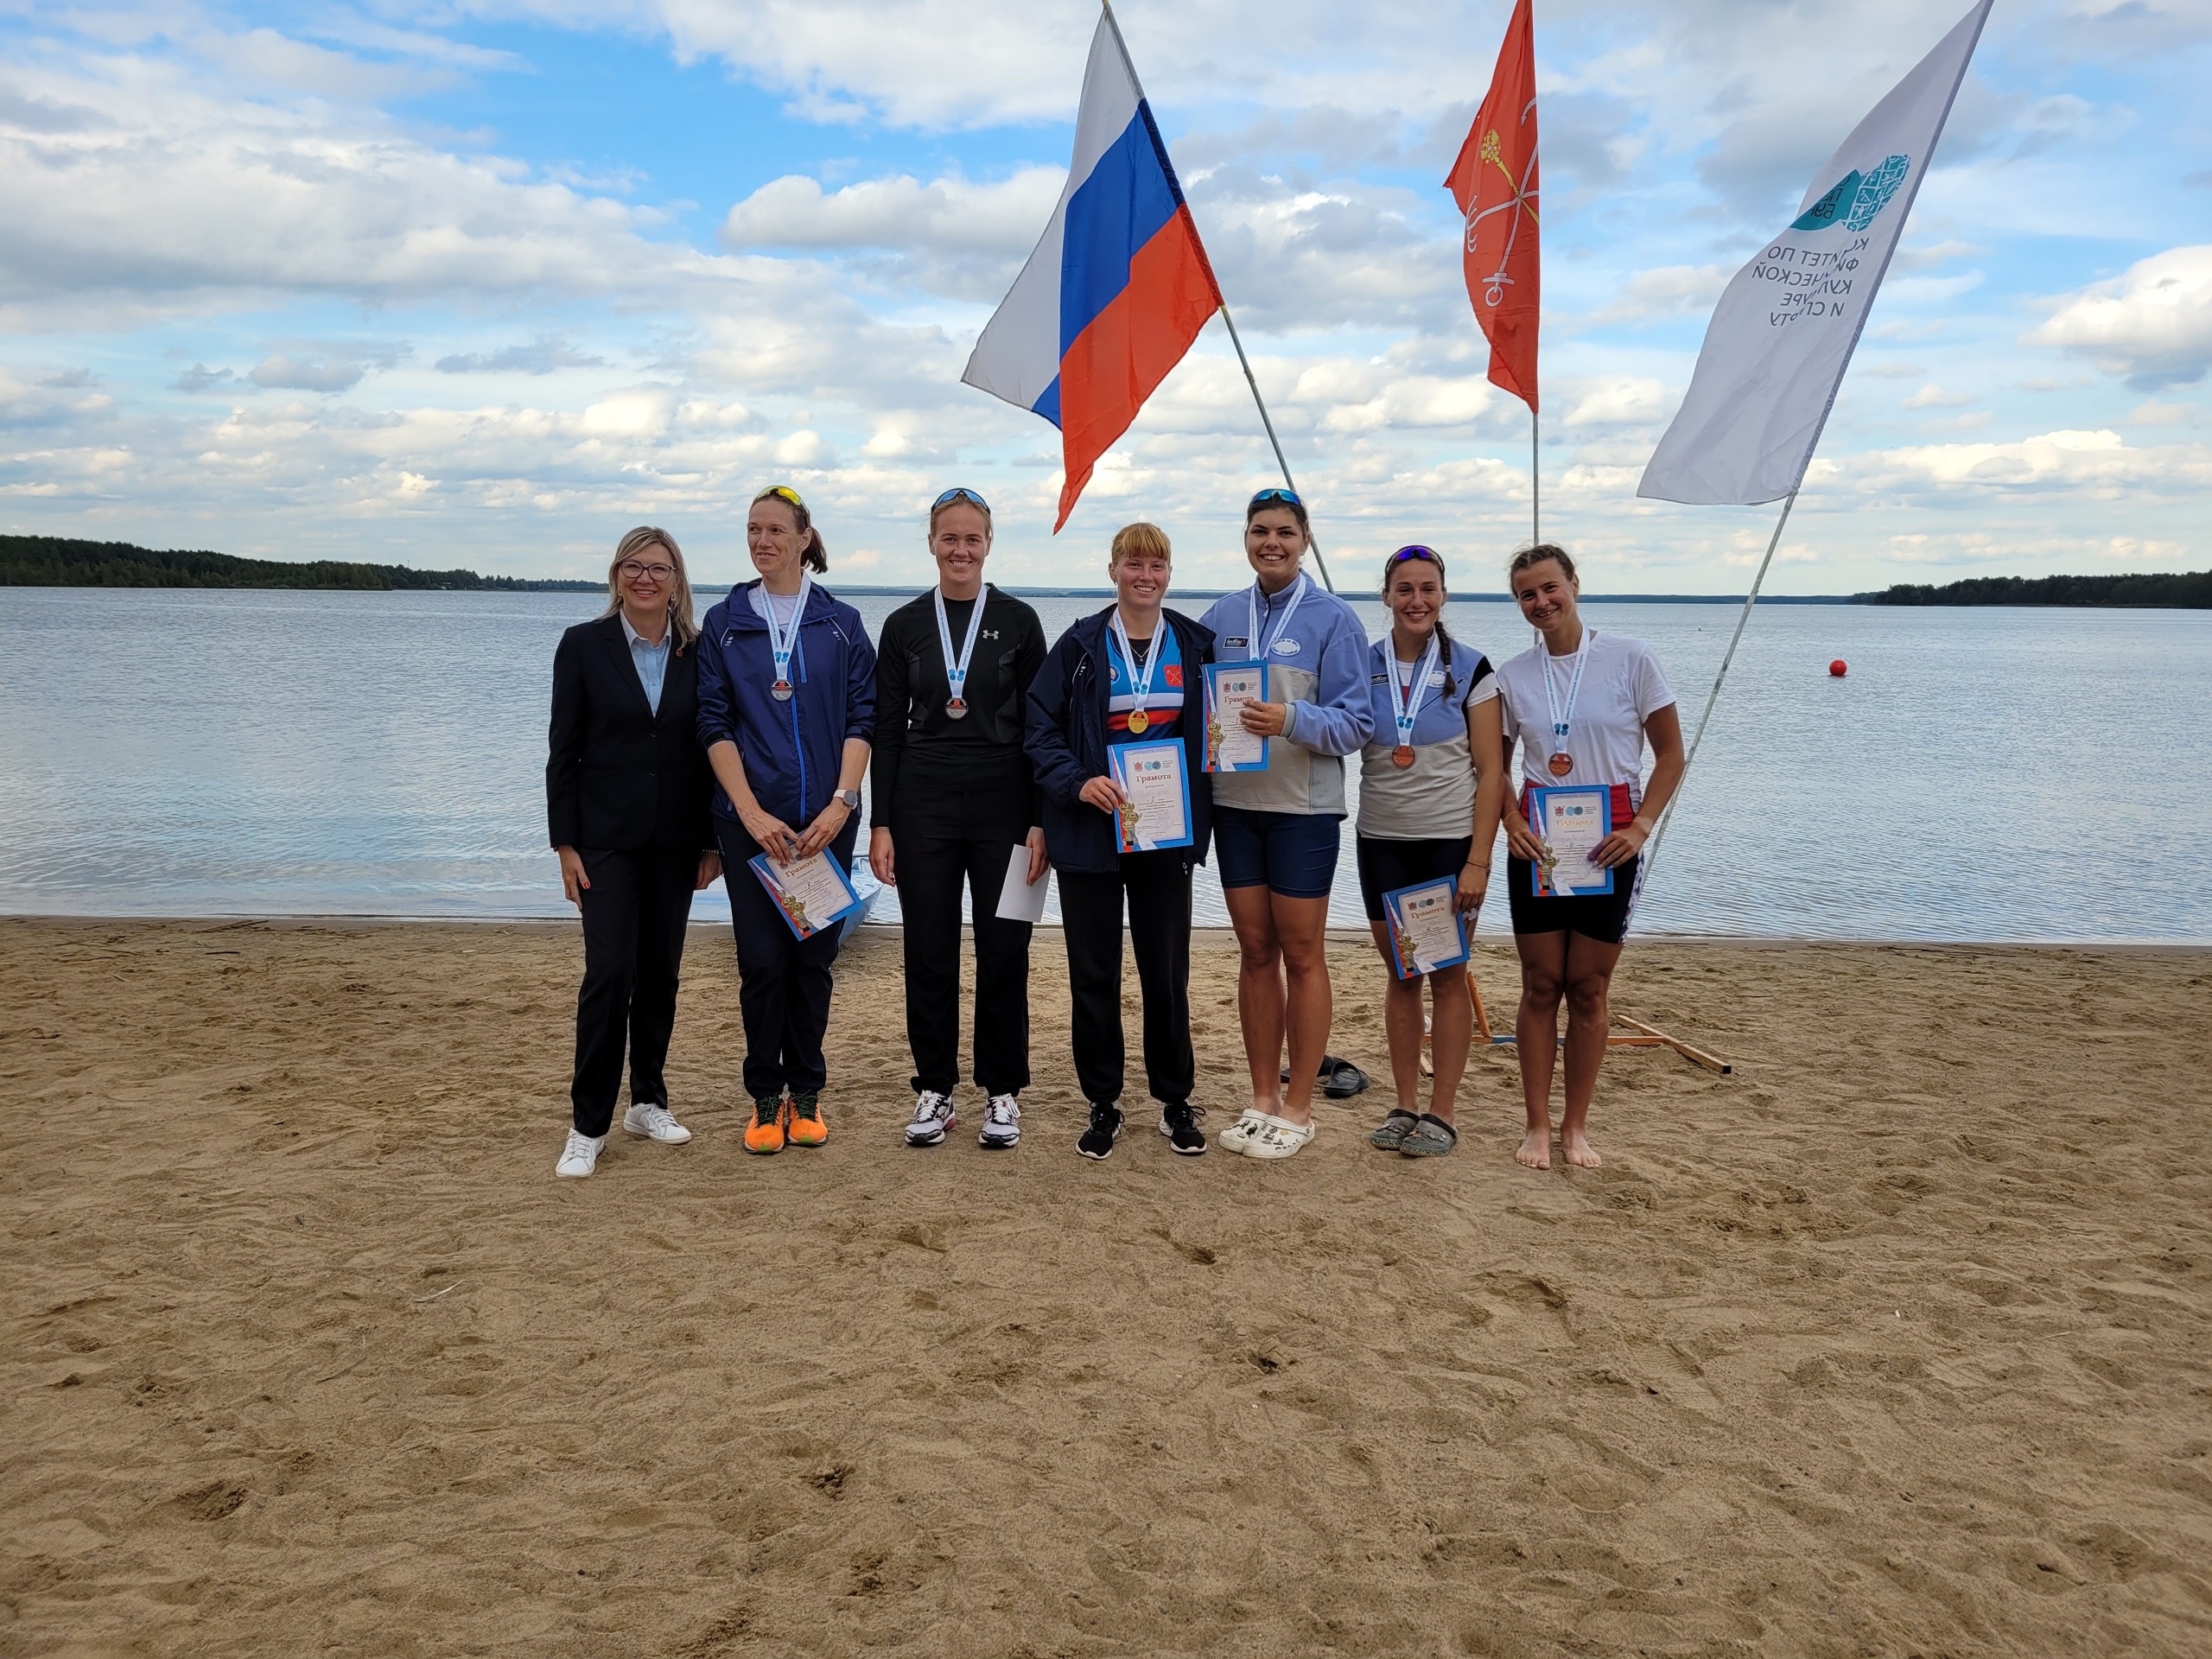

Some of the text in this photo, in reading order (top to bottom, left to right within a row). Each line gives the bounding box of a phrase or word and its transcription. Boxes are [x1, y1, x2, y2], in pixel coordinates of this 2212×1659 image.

[1224, 696, 1255, 704] Грамота
[1135, 774, 1172, 784] Грамота
[1554, 819, 1593, 830] Грамота
[785, 856, 817, 878] Грамота
[1411, 906, 1445, 918] Грамота
